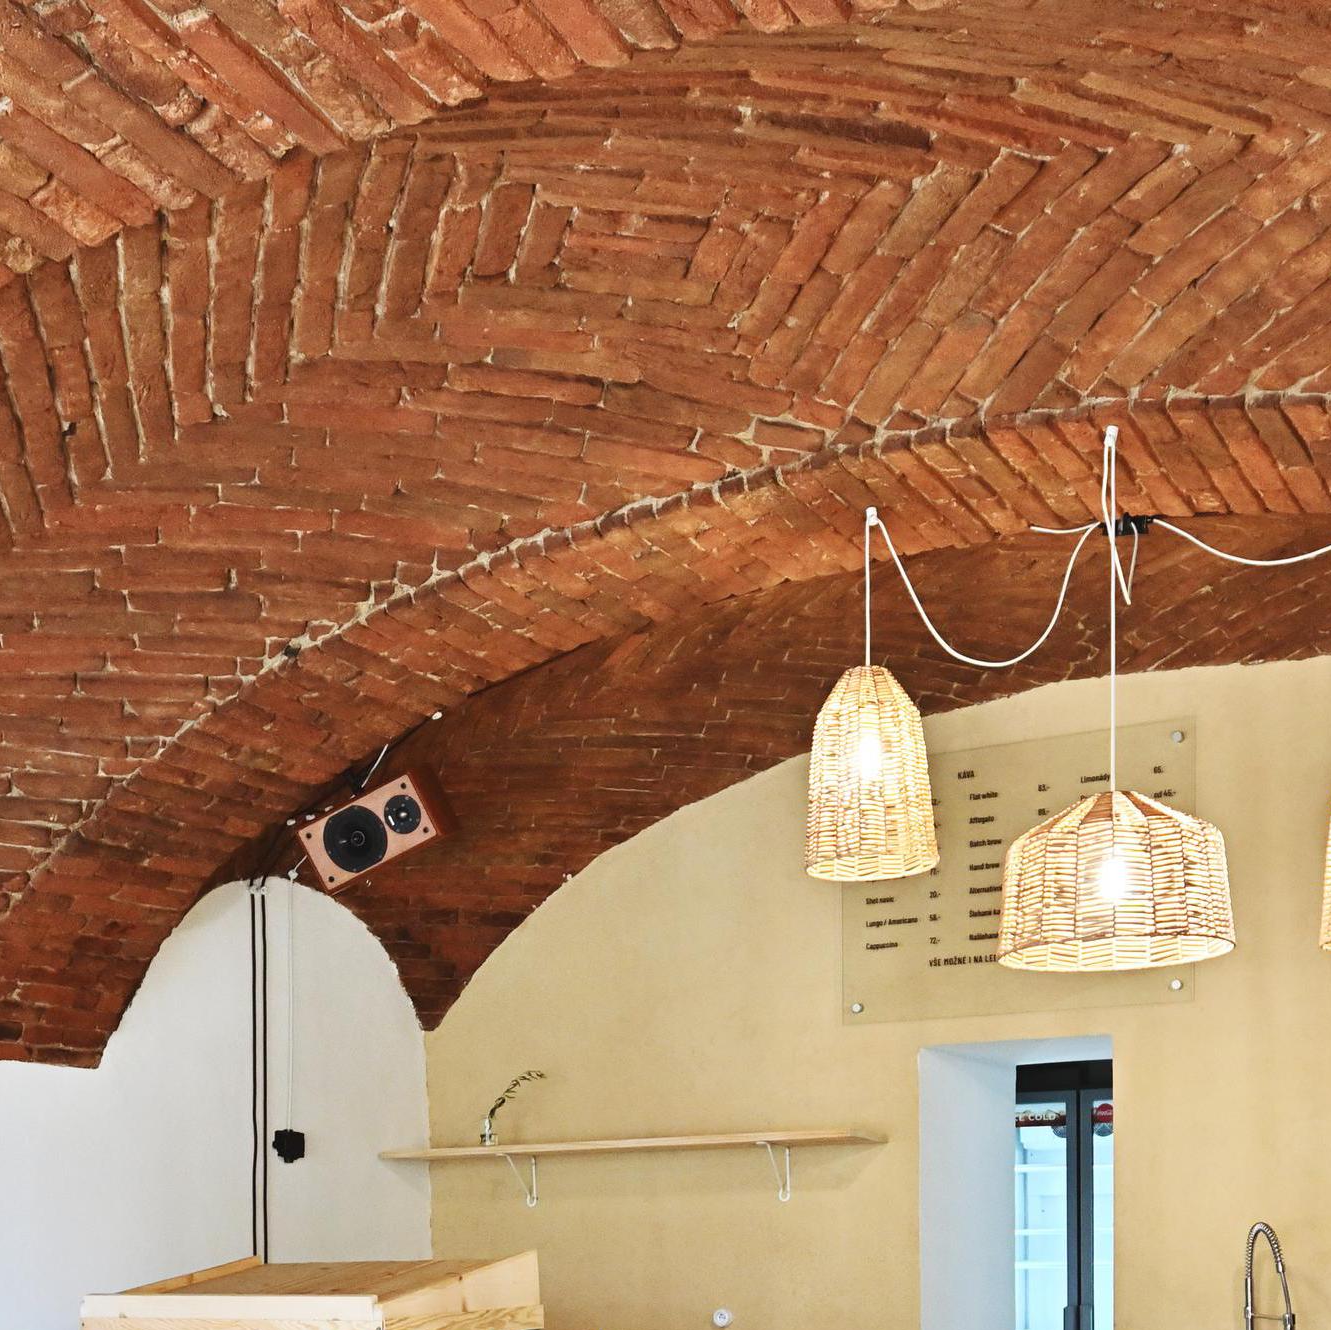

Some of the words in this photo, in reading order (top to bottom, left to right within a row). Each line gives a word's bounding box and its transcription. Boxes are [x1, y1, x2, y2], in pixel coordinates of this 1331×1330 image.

[982, 791, 998, 799] white
[888, 917, 918, 925] Americano
[1028, 1113, 1057, 1121] COLD
